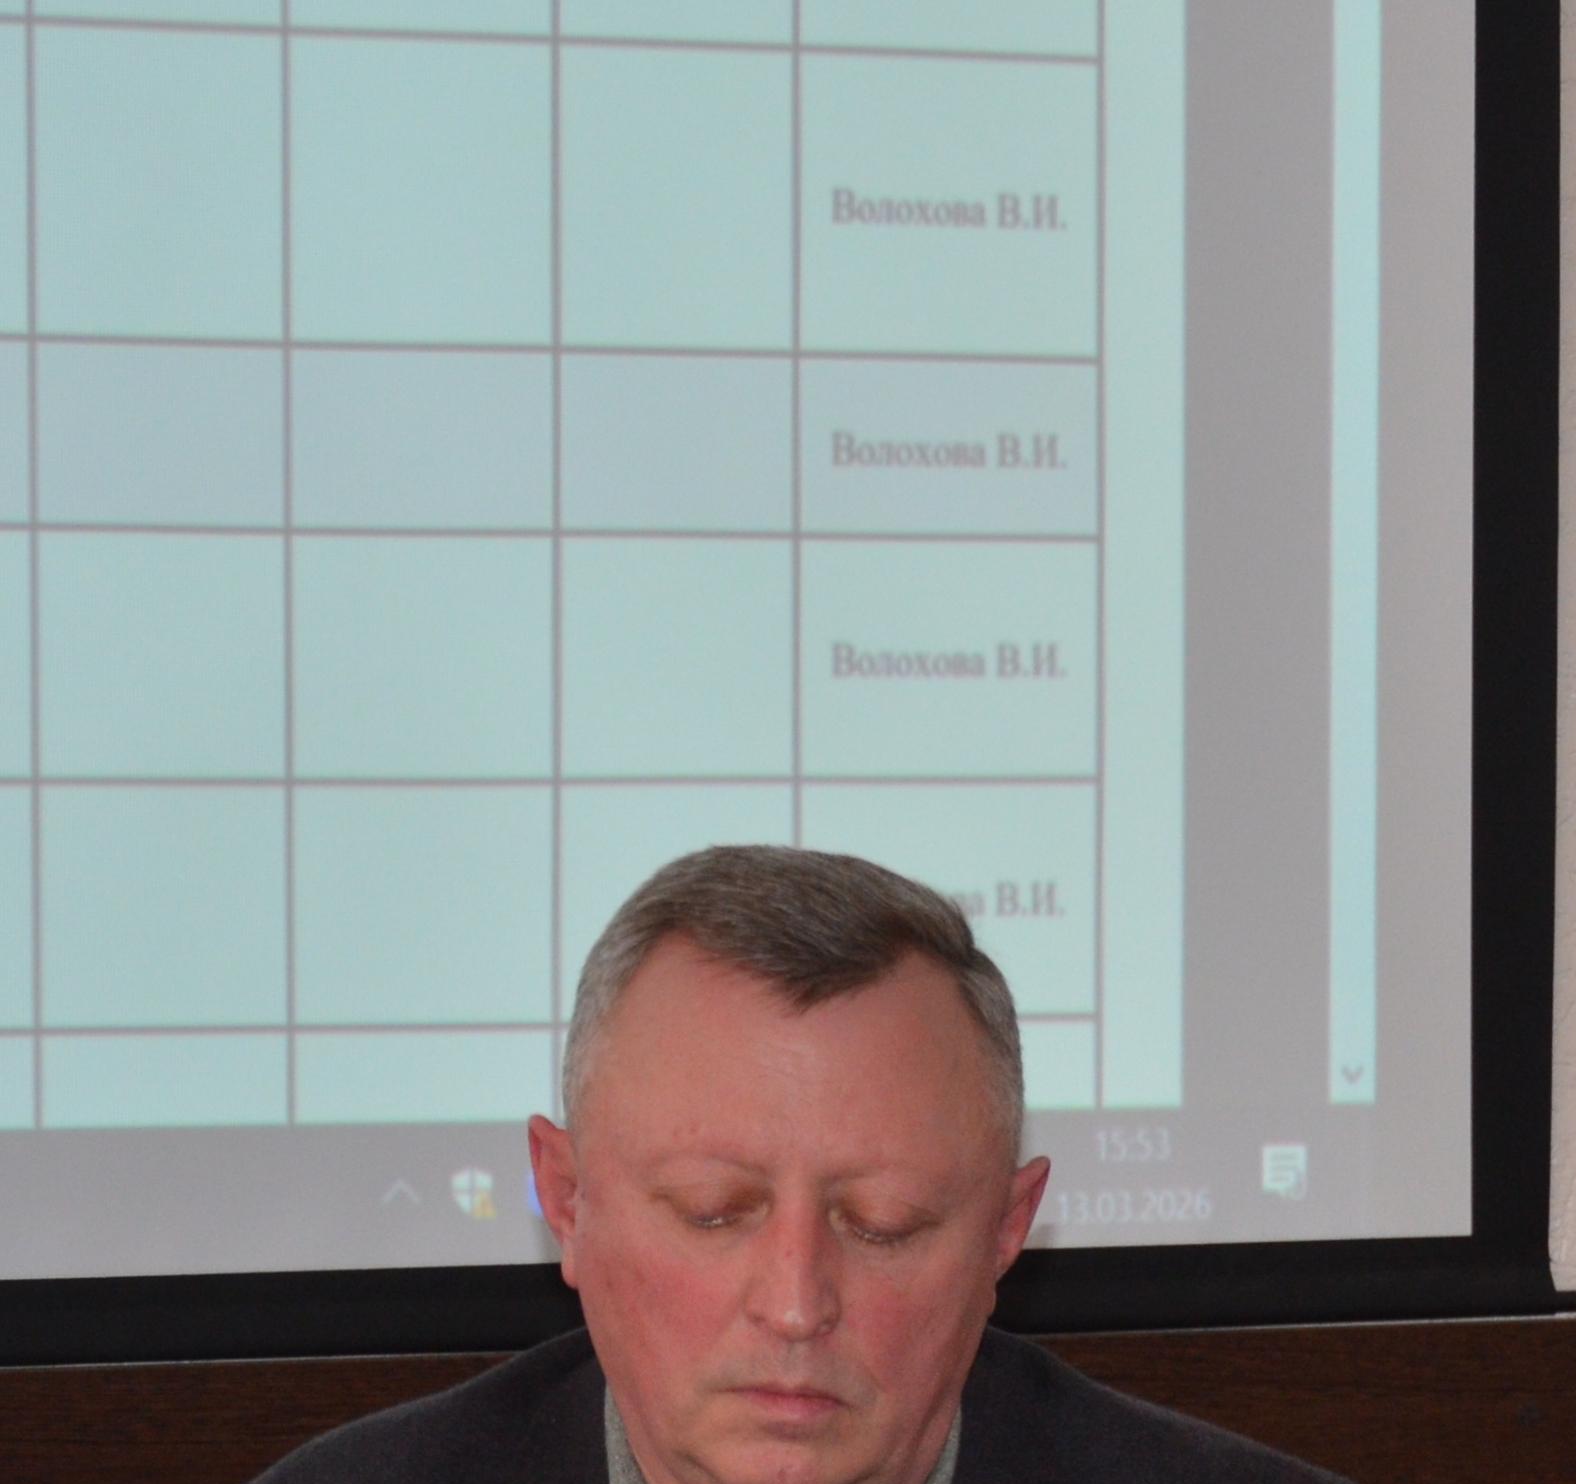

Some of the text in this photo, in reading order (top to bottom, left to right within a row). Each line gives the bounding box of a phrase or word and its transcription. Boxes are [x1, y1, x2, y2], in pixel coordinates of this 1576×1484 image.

[831, 187, 986, 229] Волохова
[831, 430, 986, 468] Волохова
[831, 641, 986, 679] Волохова
[1056, 1188, 1212, 1223] 13.03.2026
